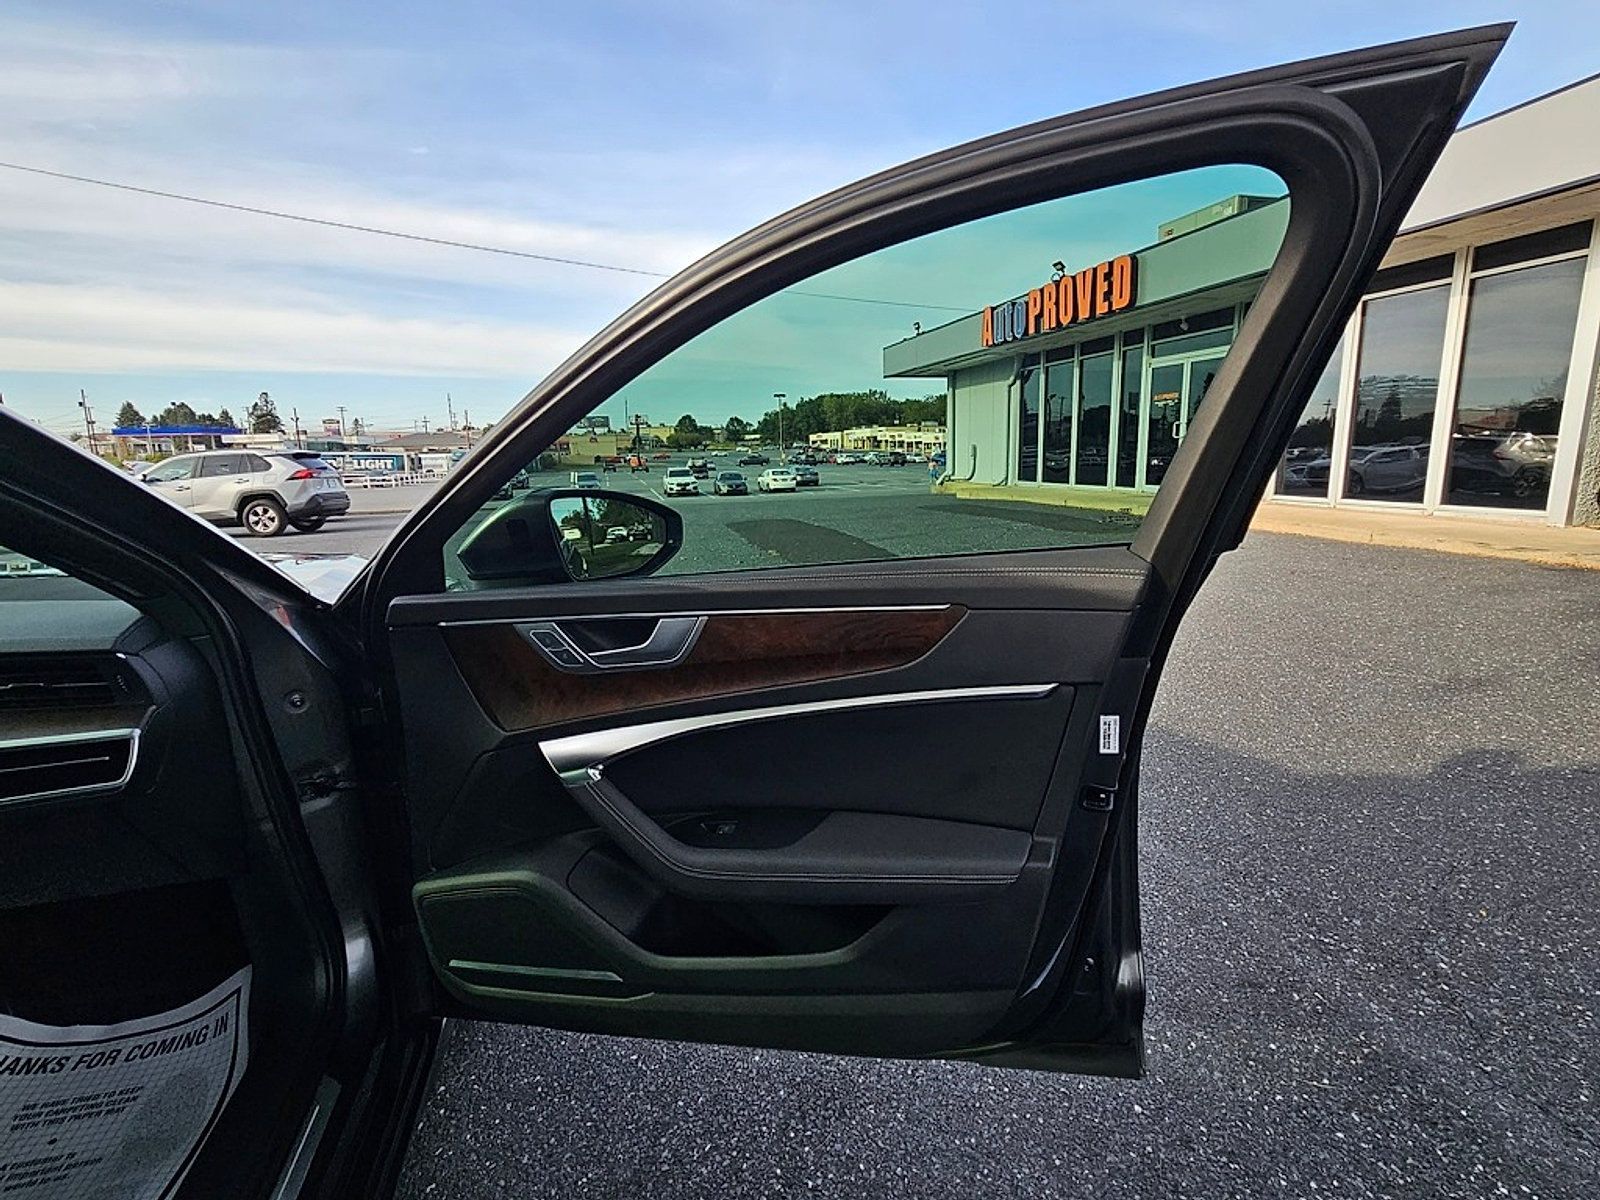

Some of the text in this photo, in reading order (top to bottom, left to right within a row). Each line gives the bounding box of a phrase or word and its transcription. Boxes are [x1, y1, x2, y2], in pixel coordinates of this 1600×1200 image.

[352, 459, 394, 470] LIGHT
[71, 1048, 123, 1071] FOR
[124, 1025, 210, 1063] COMING
[212, 1012, 229, 1037] IN
